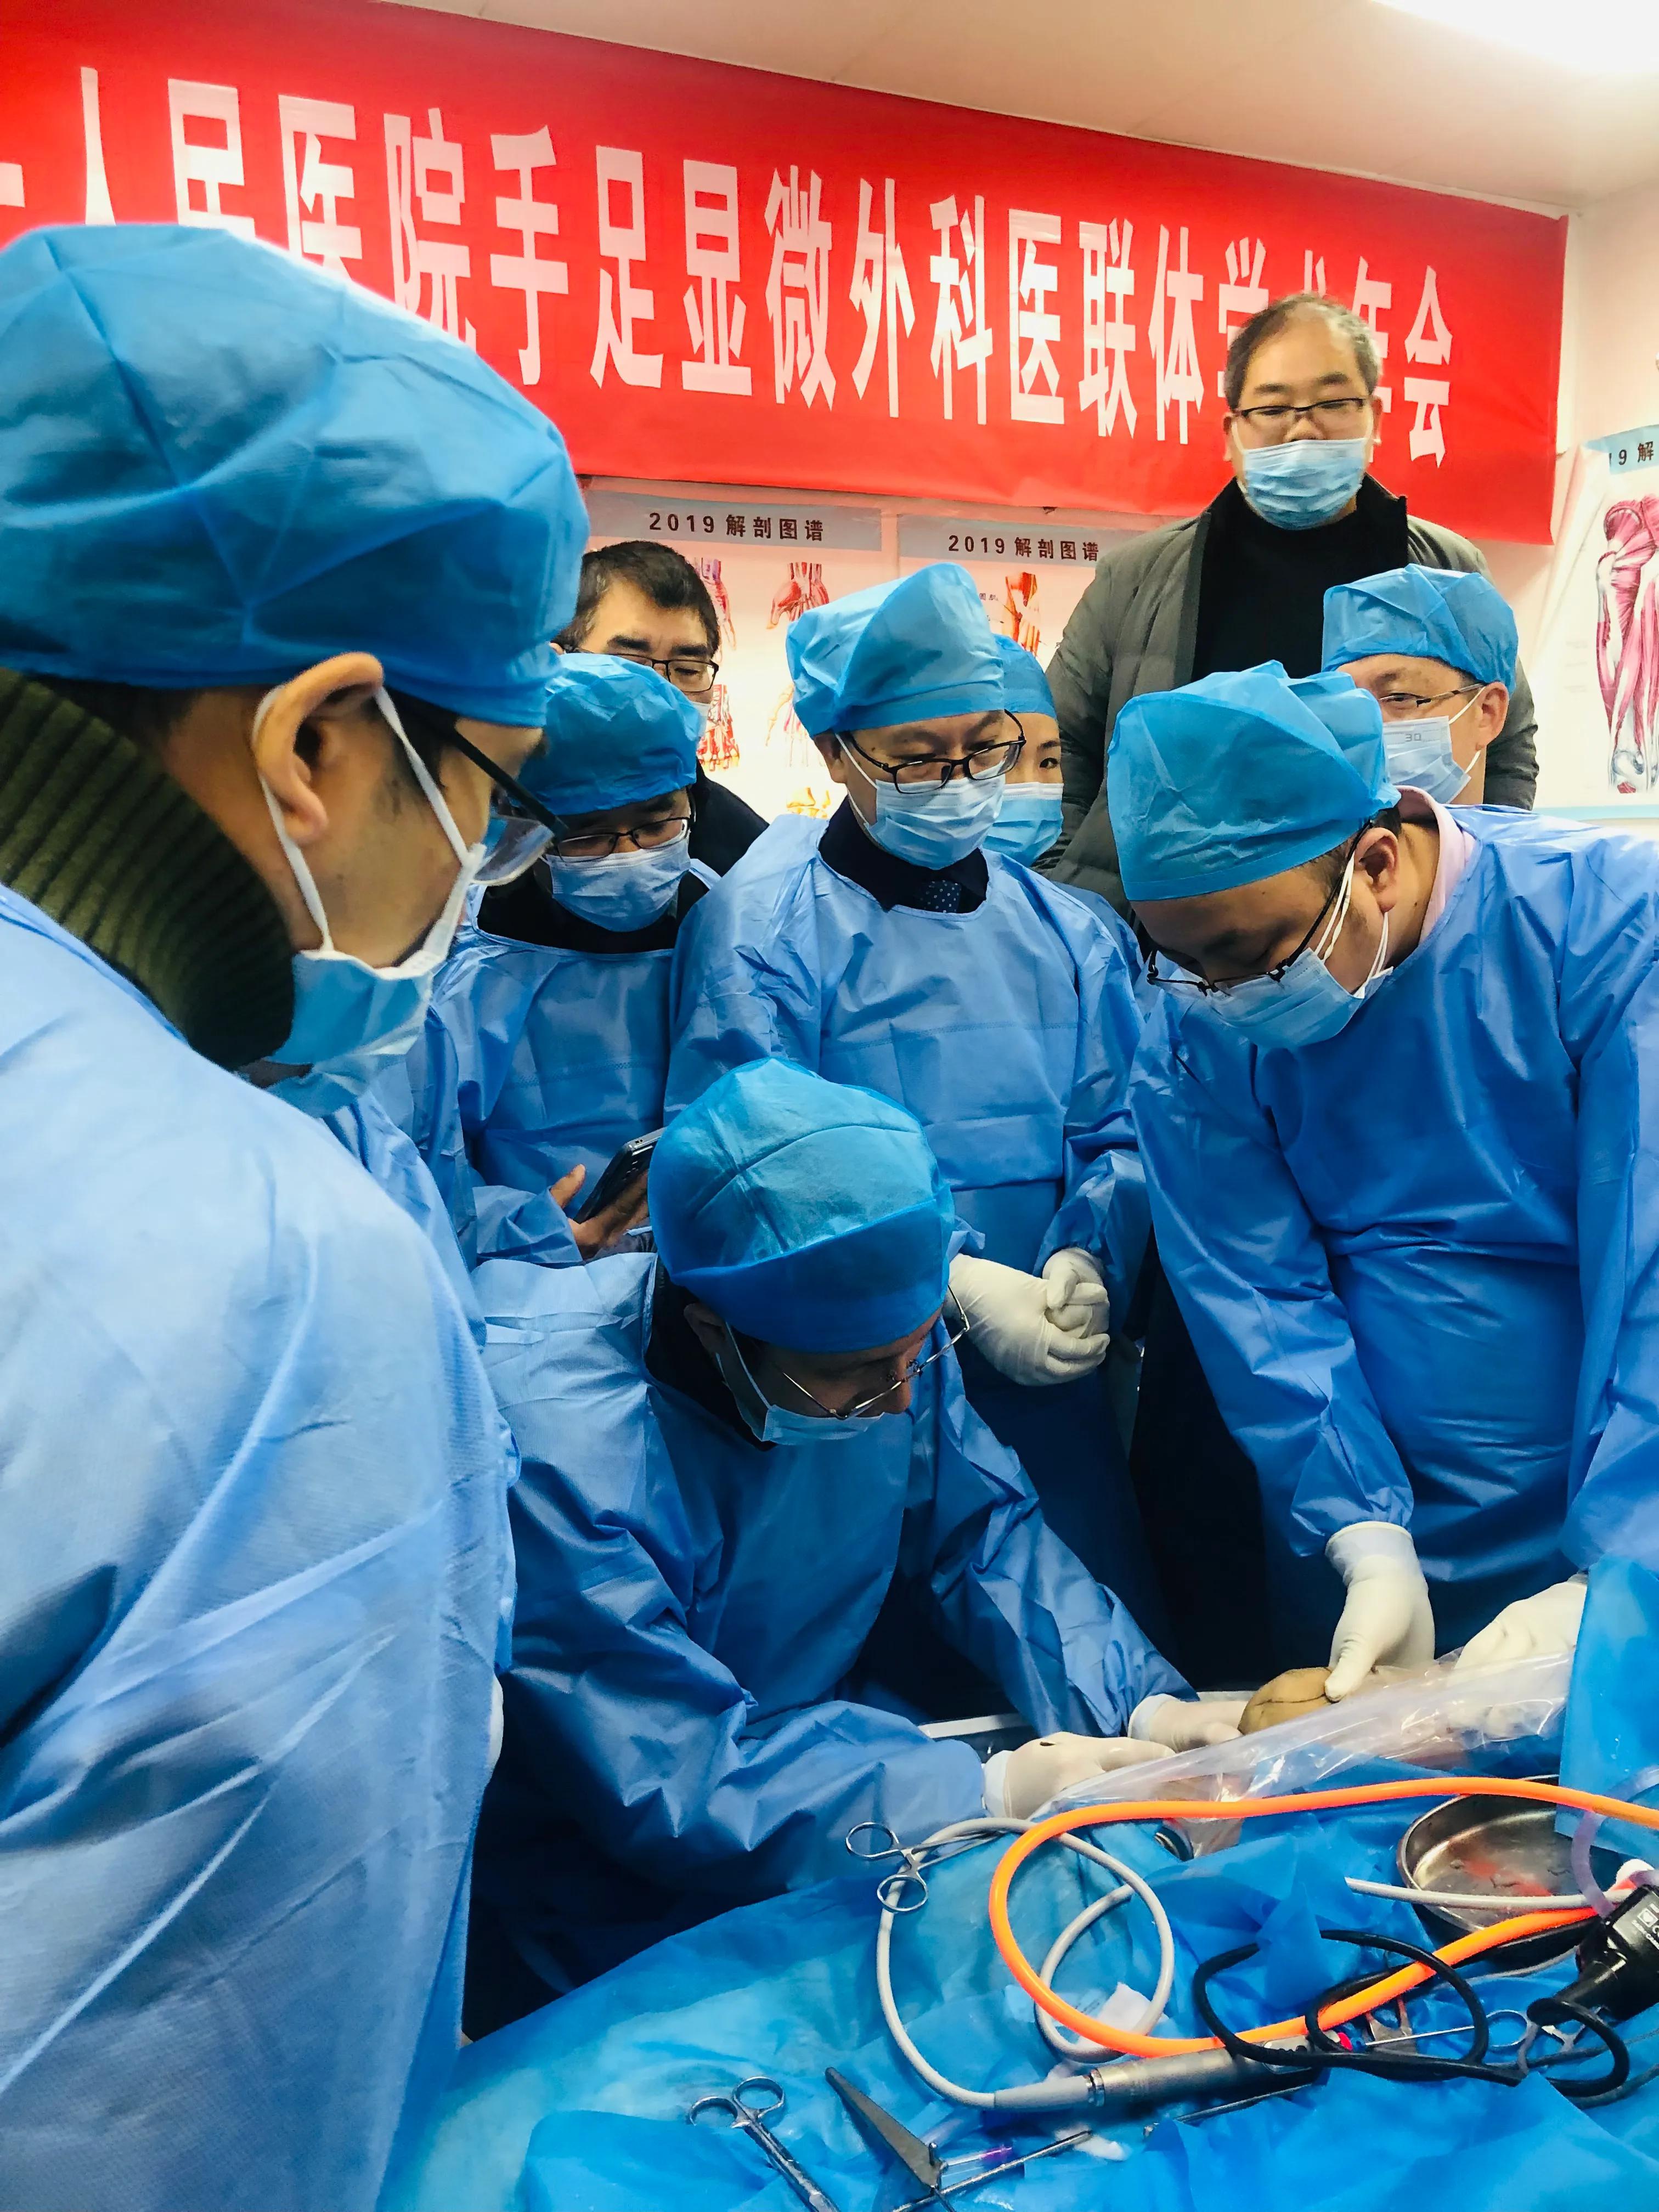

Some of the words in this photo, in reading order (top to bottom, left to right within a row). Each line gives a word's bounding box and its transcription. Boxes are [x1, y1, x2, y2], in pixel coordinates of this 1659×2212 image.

[1638, 442, 1653, 462] 解
[650, 512, 714, 533] 2019
[726, 515, 823, 541] 解剖图谱
[949, 535, 1005, 554] 2019
[1014, 537, 1098, 561] 解剖图谱
